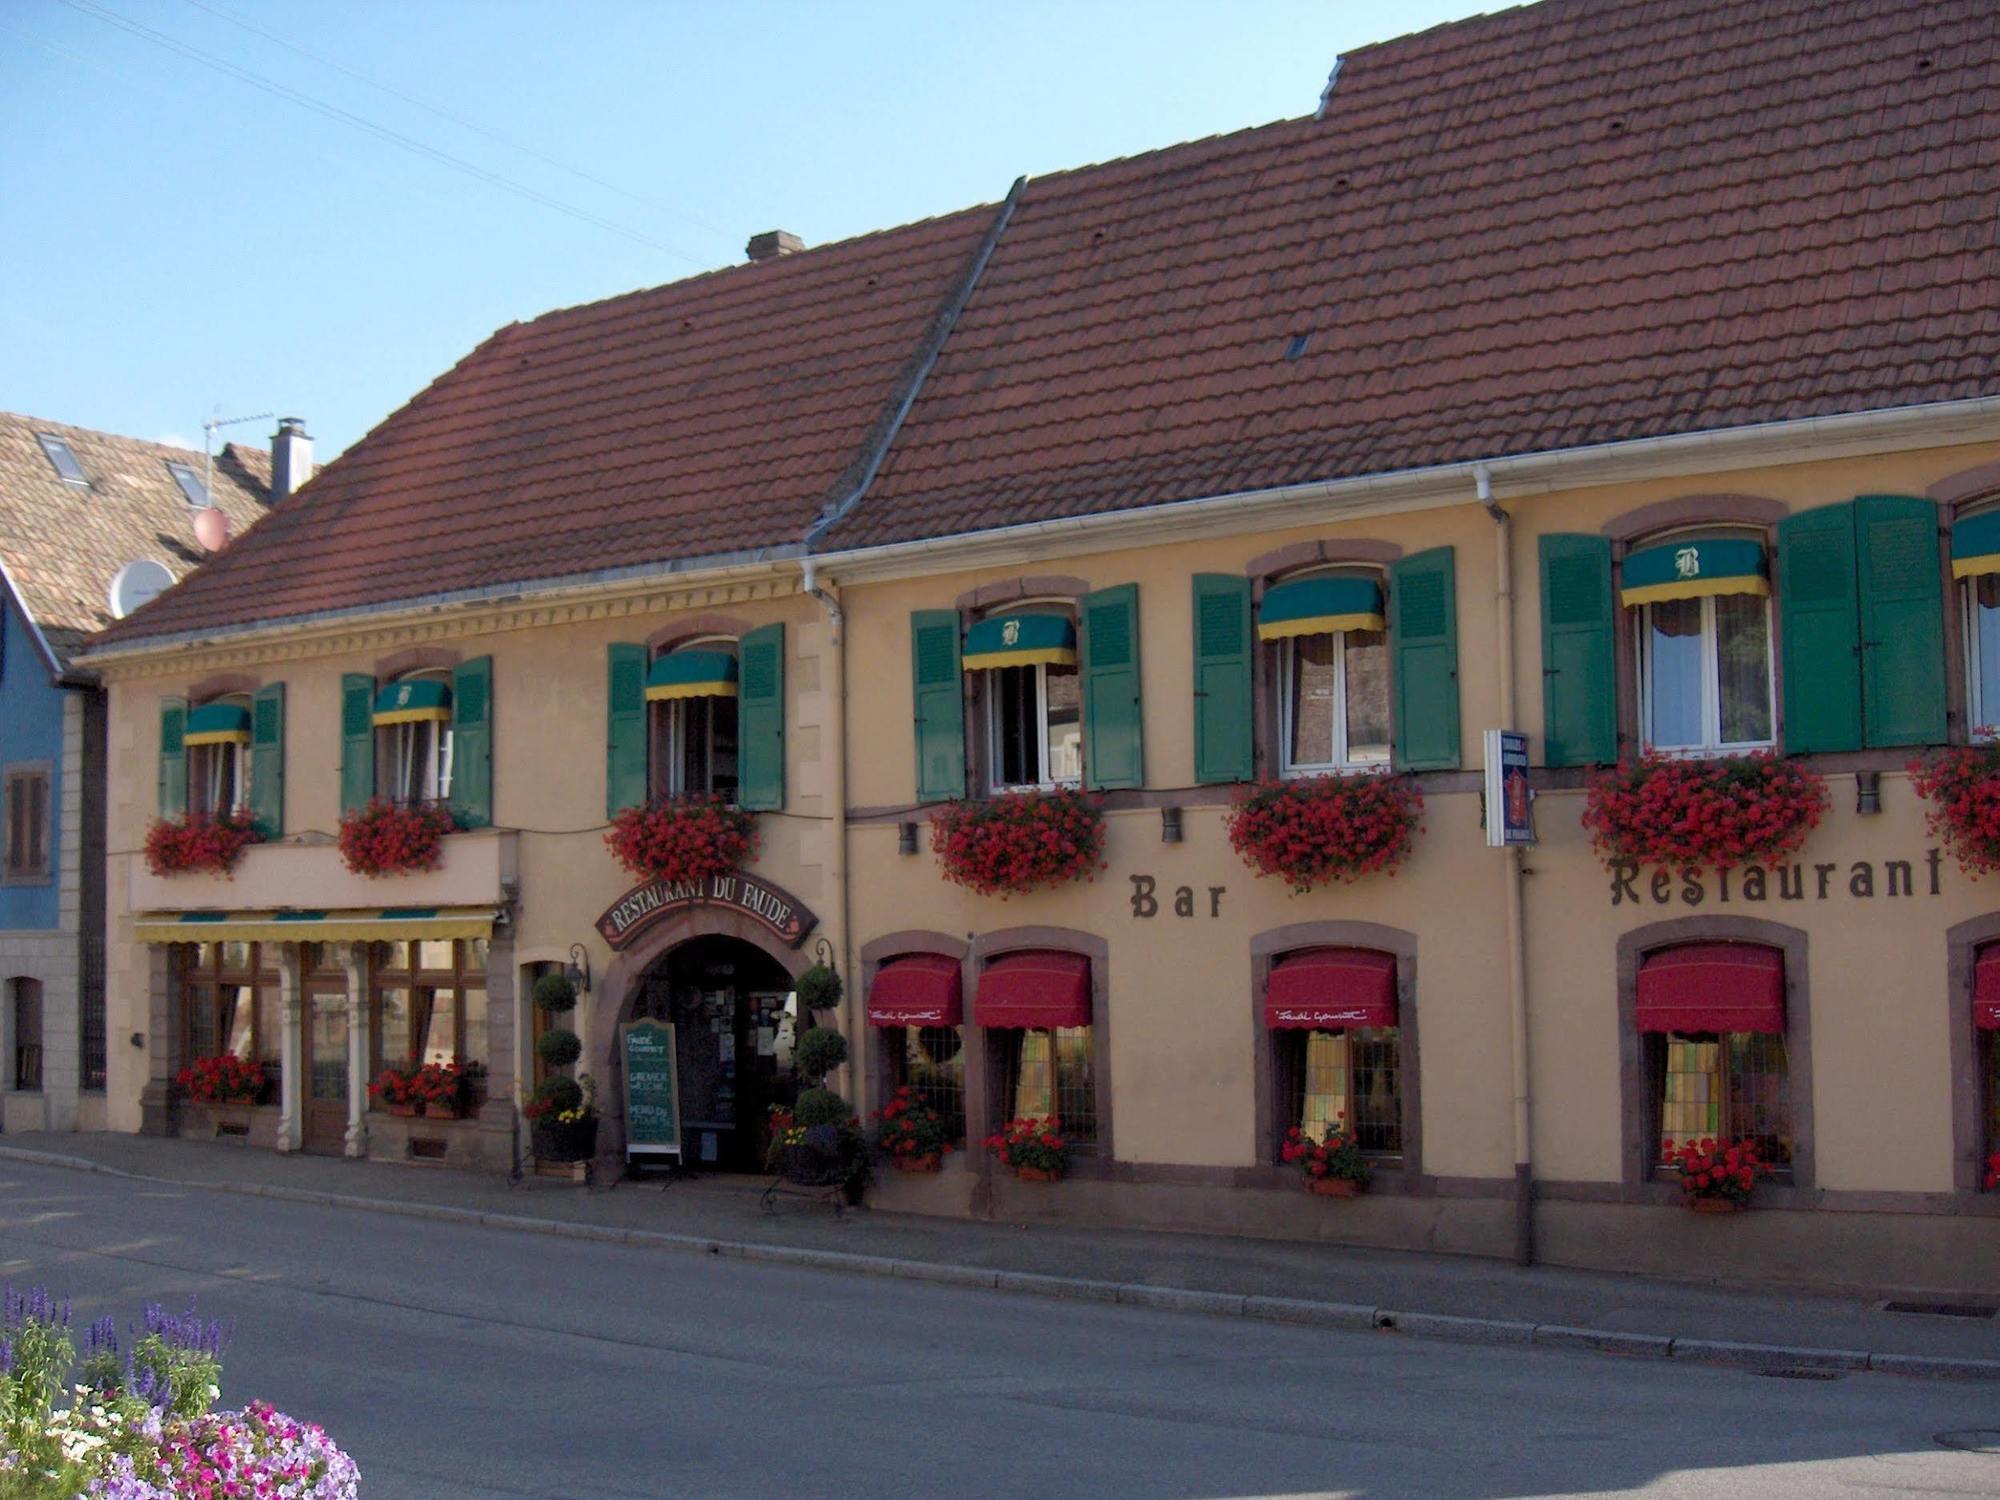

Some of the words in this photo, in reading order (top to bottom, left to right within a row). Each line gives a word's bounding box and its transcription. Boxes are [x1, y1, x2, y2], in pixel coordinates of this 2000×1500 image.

[611, 877, 705, 933] RESTAURANT
[713, 876, 737, 901] DU
[741, 883, 791, 928] FAUDE
[1129, 873, 1226, 918] Bar
[1608, 847, 1943, 907] Restaurant
